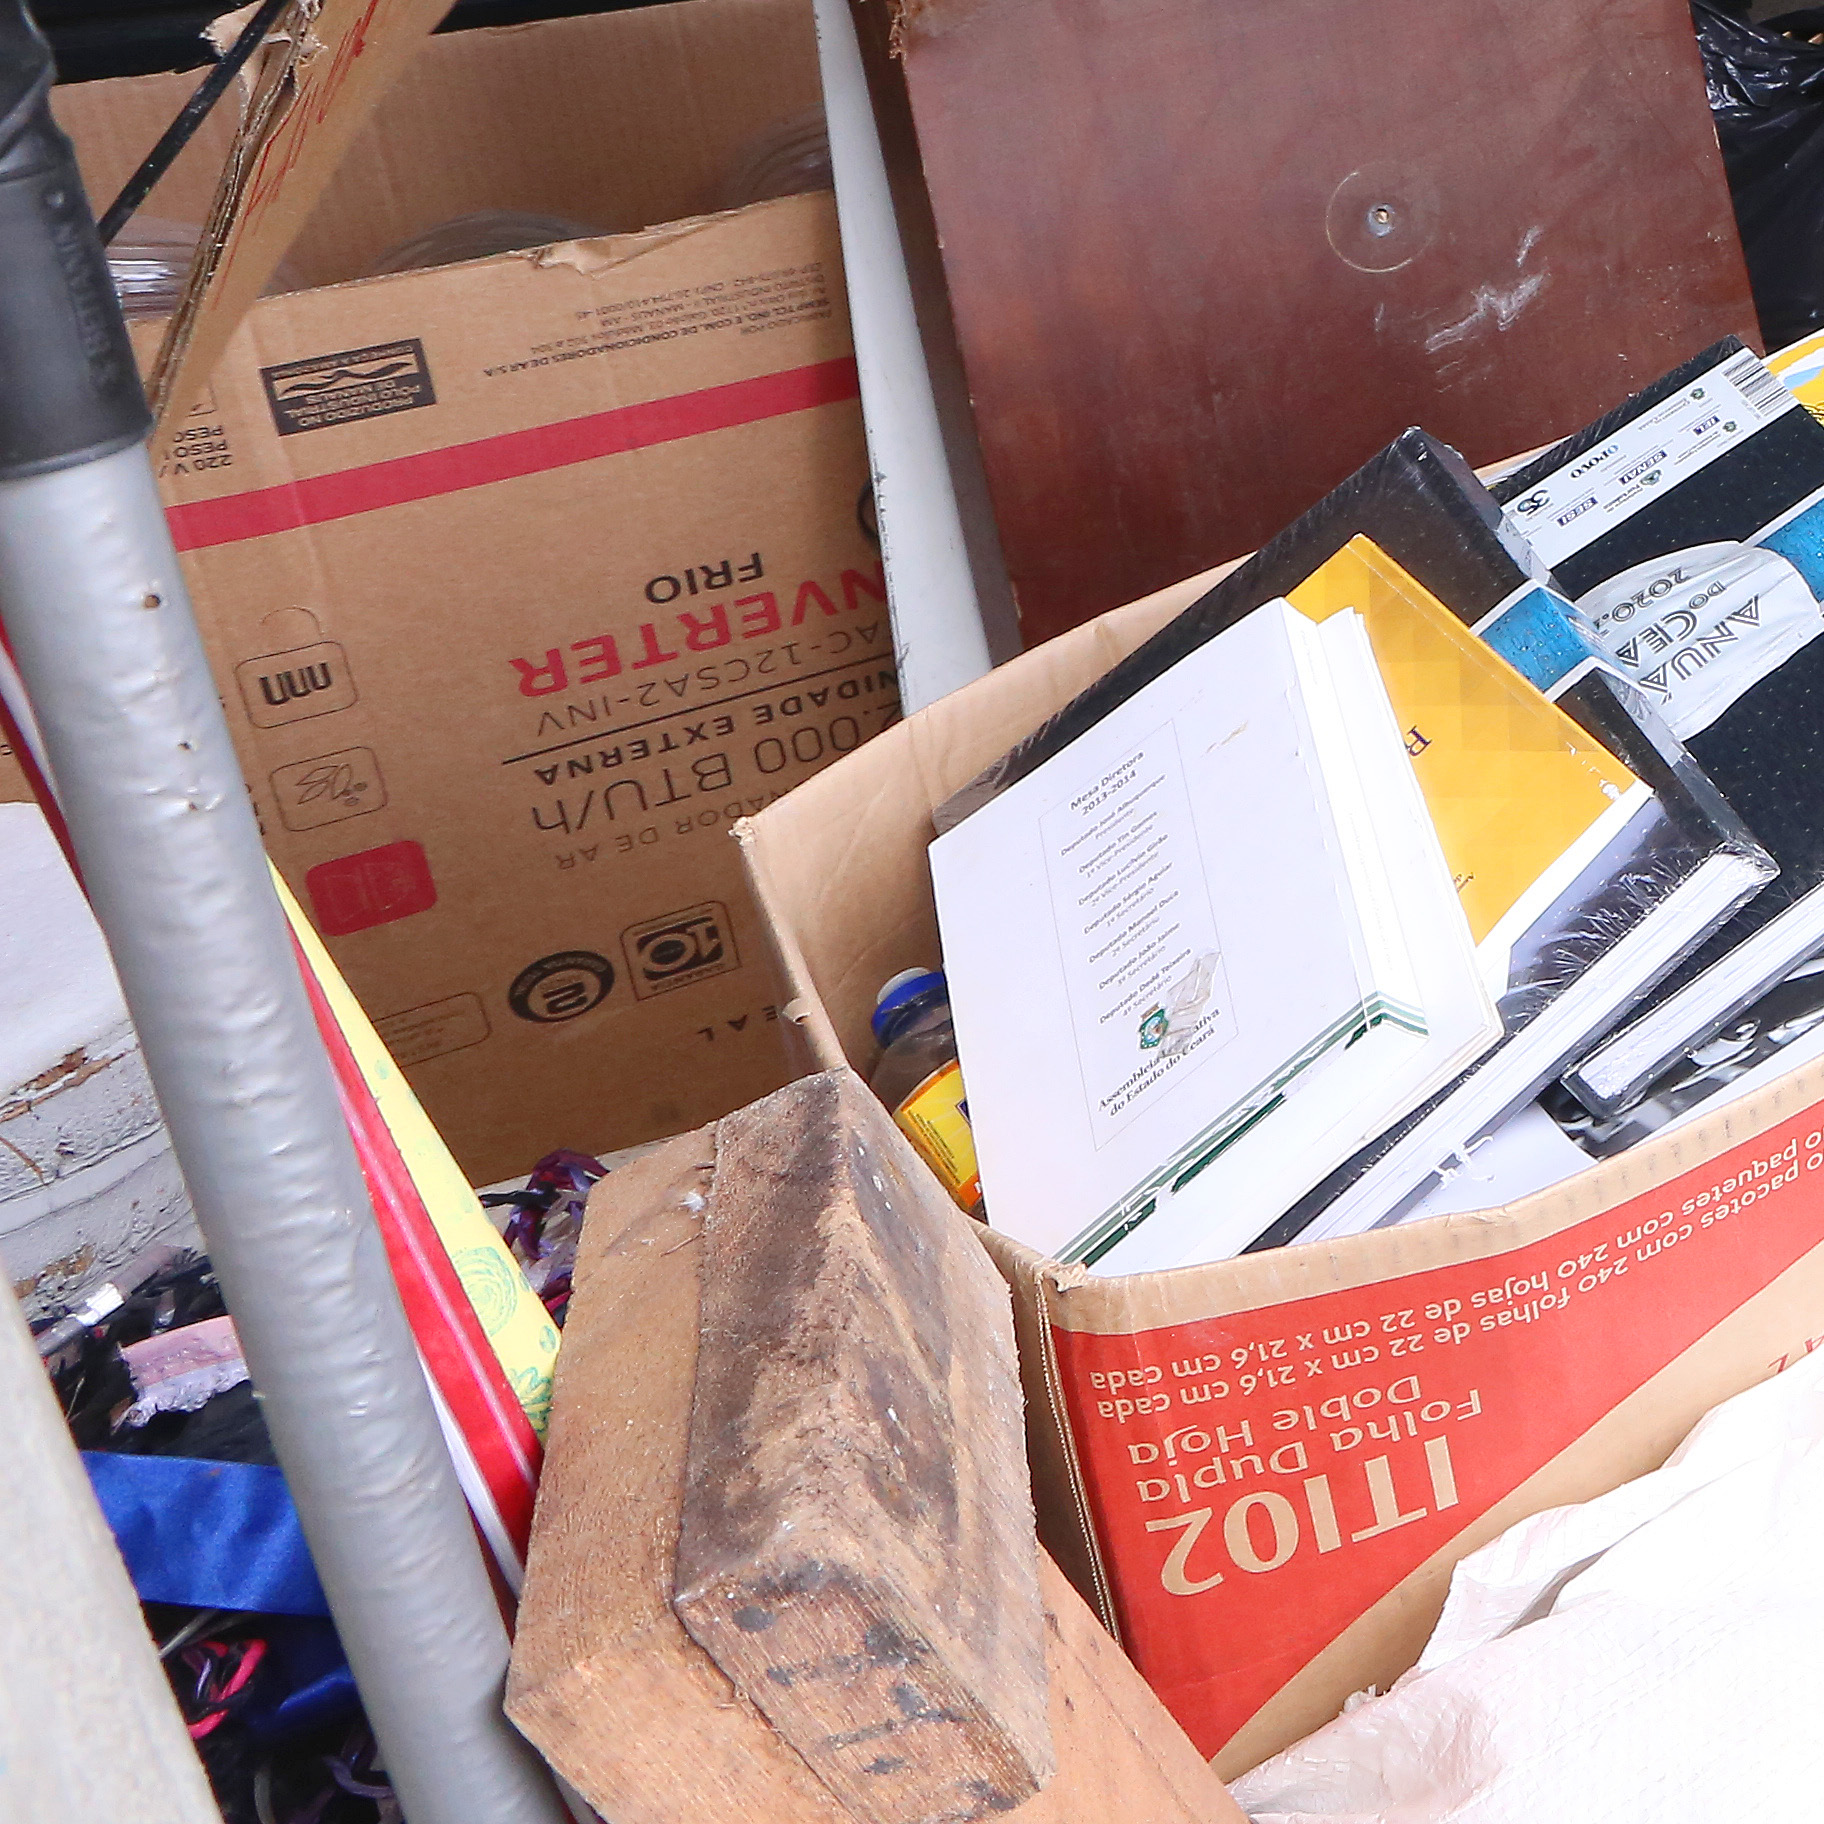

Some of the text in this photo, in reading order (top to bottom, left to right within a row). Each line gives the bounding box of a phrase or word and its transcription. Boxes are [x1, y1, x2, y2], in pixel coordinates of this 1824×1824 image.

[193, 454, 232, 471] 220
[1618, 448, 1667, 484] SENAI
[1556, 496, 1597, 526] SESI
[643, 551, 764, 604] FRIO
[1687, 579, 1726, 609] DO
[532, 714, 734, 786] EXTERNA
[529, 752, 733, 834] BTU/h
[1070, 751, 1144, 811] Mesa Diretora
[1082, 769, 1137, 817] 2013-2014
[553, 842, 600, 870] AR
[612, 826, 659, 853] DE
[1110, 1101, 1126, 1117] do
[1126, 1066, 1165, 1104] Estado
[1165, 1054, 1181, 1072] do
[1679, 1136, 1798, 1218] paquetes
[1698, 1157, 1800, 1227] pacotes
[1615, 1207, 1675, 1252] com
[1632, 1220, 1693, 1263] com
[1556, 1242, 1609, 1279] 240
[1577, 1255, 1630, 1293] 240
[1468, 1268, 1550, 1311] hojas
[1379, 1308, 1414, 1333] 22
[1422, 1297, 1462, 1327] de
[1478, 1281, 1571, 1334] folhas
[1294, 1332, 1313, 1351] x
[1320, 1320, 1370, 1348] cm
[1389, 1332, 1424, 1356] 22
[1432, 1320, 1471, 1348] de
[1170, 1350, 1221, 1378] cm
[1229, 1338, 1287, 1369] 21,6
[1303, 1357, 1322, 1376] x
[1329, 1344, 1380, 1371] cm
[1087, 1363, 1162, 1395] cada
[1179, 1380, 1230, 1410] cm
[1238, 1362, 1295, 1395] 21,6
[1095, 1391, 1171, 1425] cada
[1126, 1373, 1422, 1467] Doble Hoja
[1134, 1388, 1482, 1504] Folha Dupla
